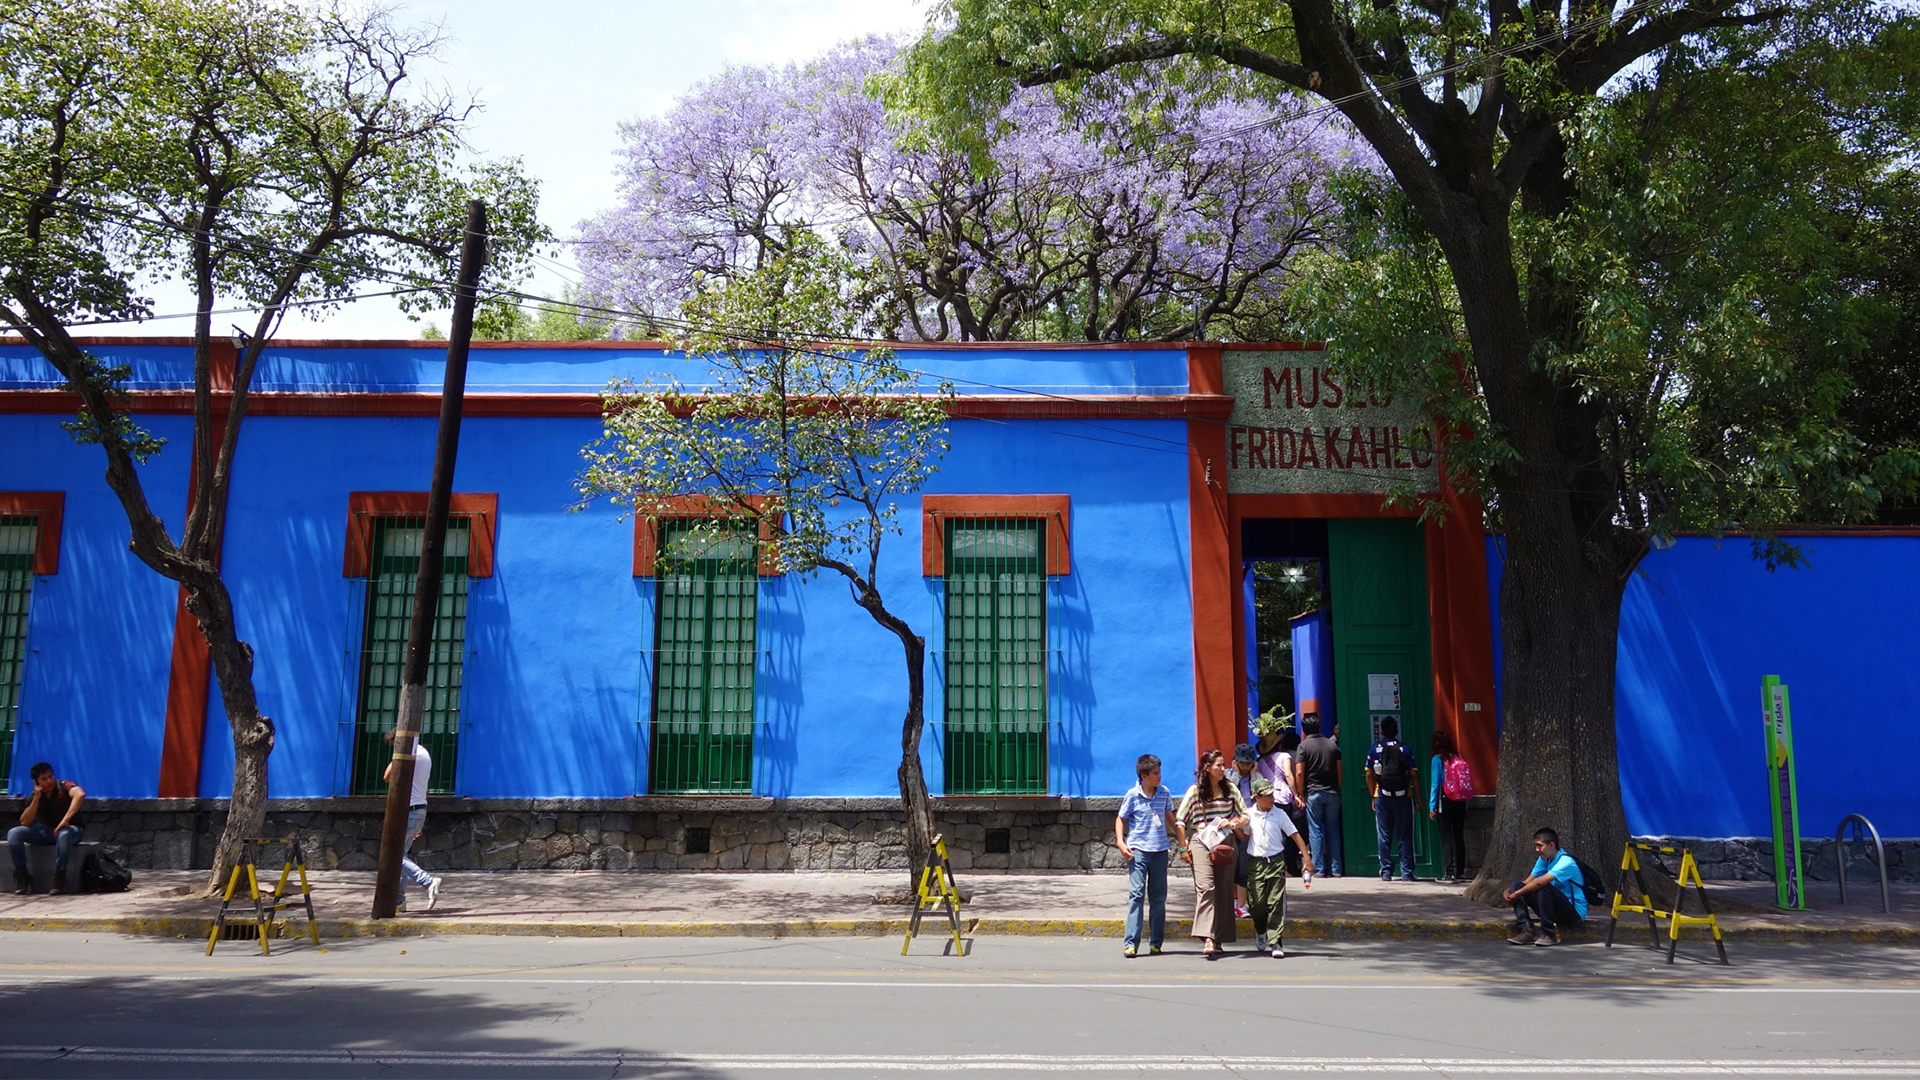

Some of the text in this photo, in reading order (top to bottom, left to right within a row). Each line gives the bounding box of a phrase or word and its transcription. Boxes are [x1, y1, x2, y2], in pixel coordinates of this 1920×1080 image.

[1231, 426, 1433, 469] FRIDA KAHLO
[1775, 703, 1783, 734] Frida
